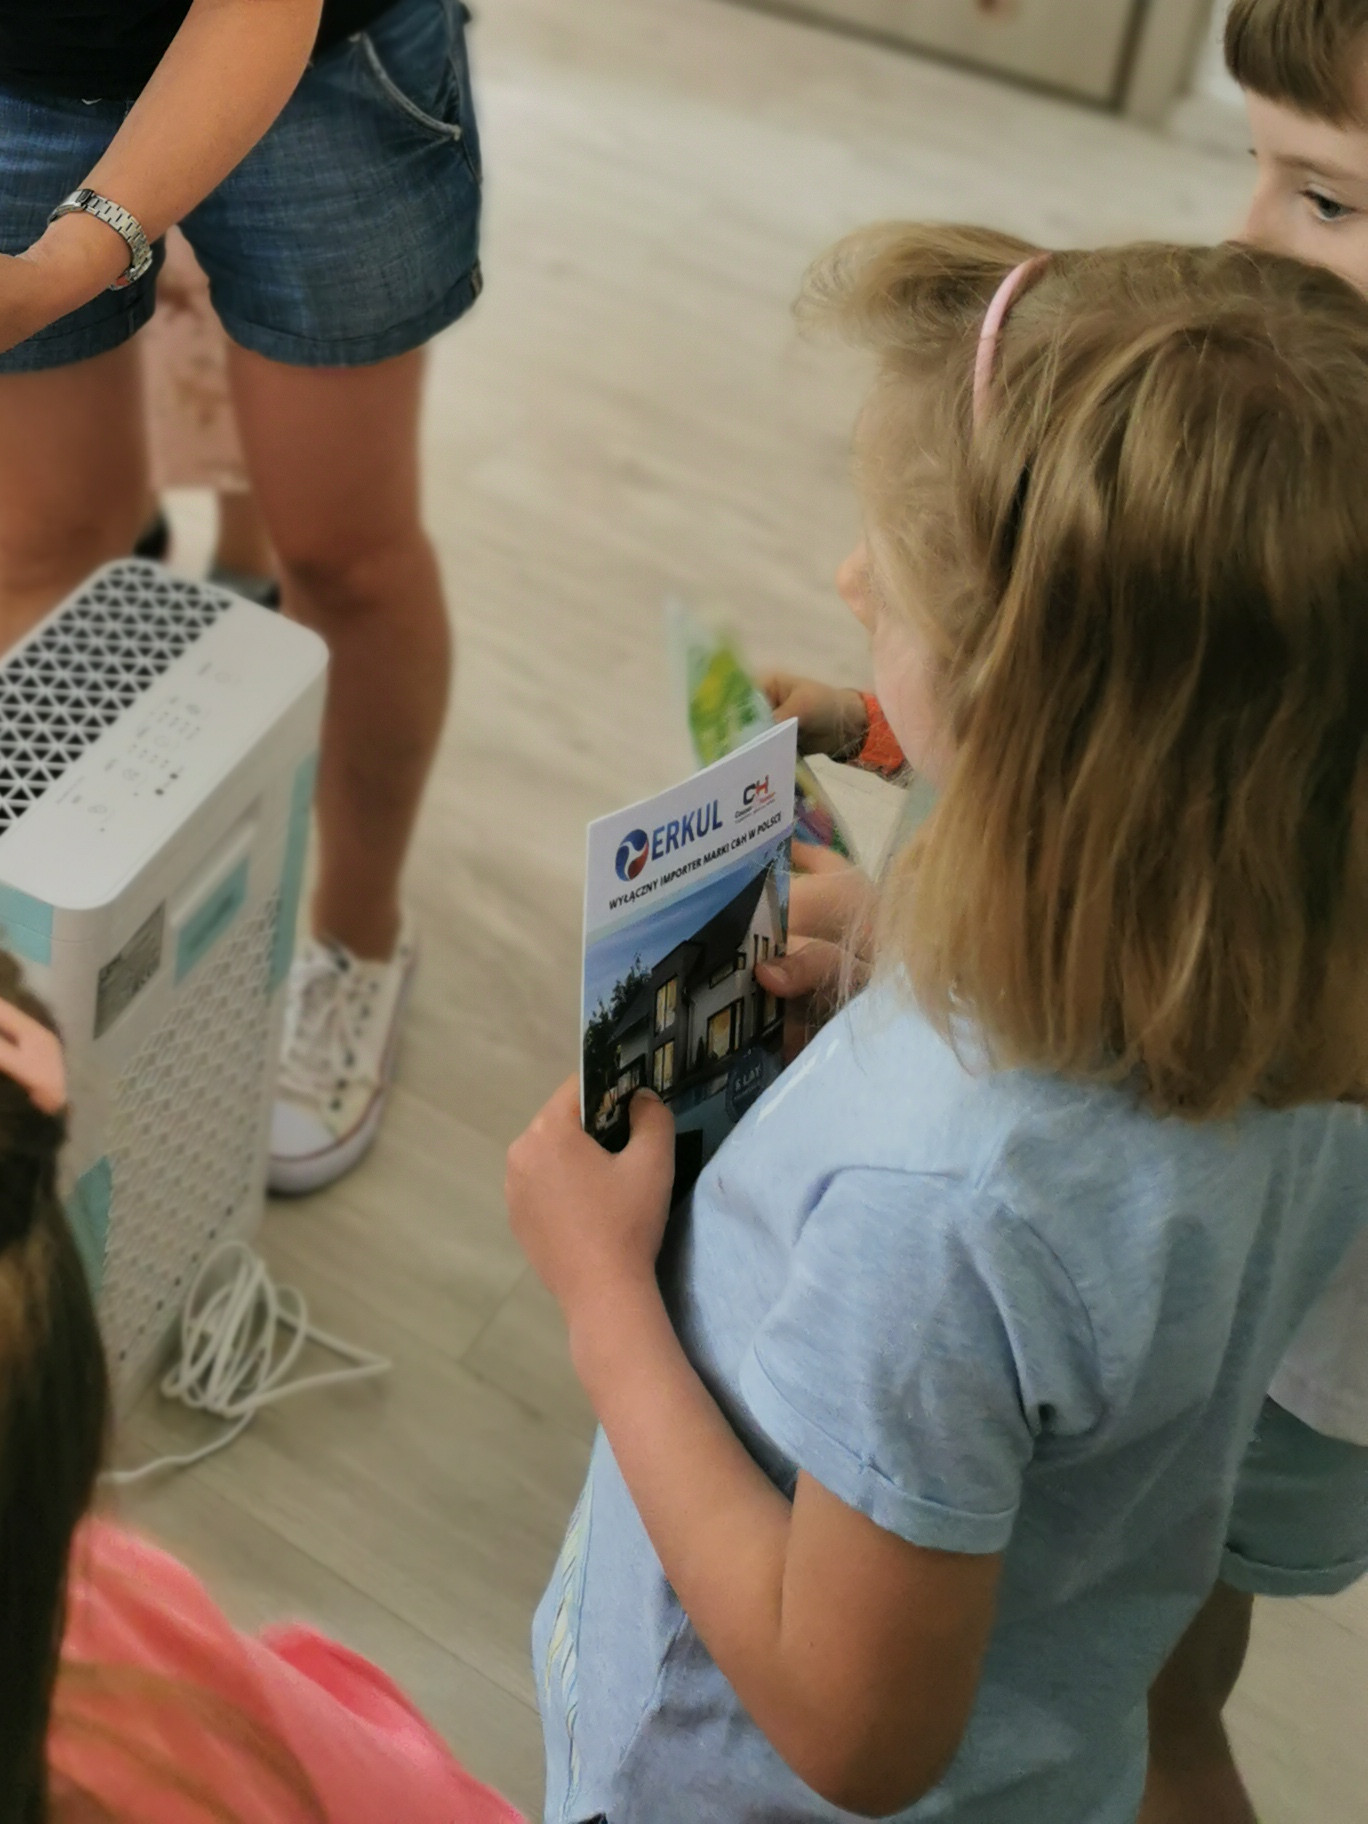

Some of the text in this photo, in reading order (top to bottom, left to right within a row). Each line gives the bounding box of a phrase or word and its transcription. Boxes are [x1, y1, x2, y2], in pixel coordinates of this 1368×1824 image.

[609, 878, 659, 911] WYŁĄCZNY
[660, 857, 702, 887] IMPORTER
[702, 842, 730, 867] MARKI
[731, 833, 748, 851] C&H
[748, 828, 756, 842] W
[757, 810, 782, 836] POLSCE
[651, 798, 724, 862] ERKUL
